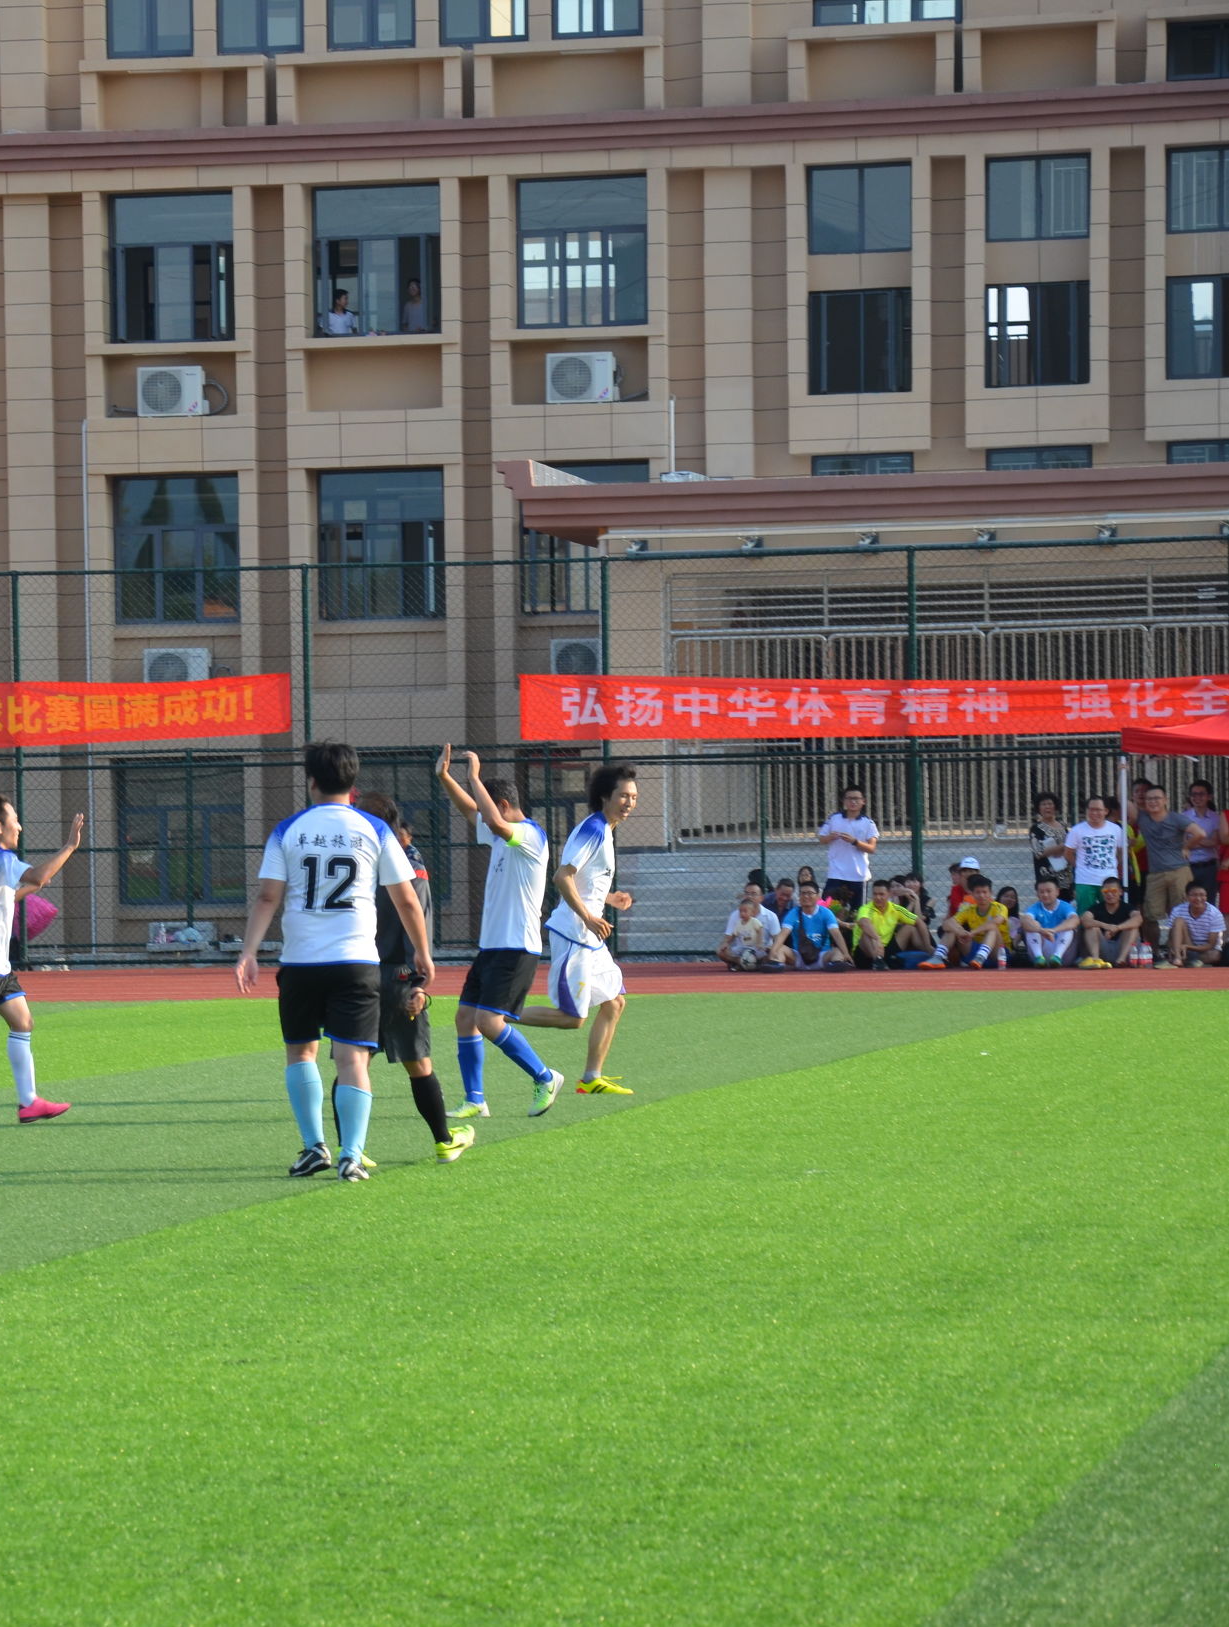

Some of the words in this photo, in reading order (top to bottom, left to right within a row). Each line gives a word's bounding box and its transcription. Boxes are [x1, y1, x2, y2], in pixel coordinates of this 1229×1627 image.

[561, 686, 1009, 727] 弘扬中华体育精神
[1061, 678, 1229, 720] 强化全
[300, 853, 360, 912] 12
